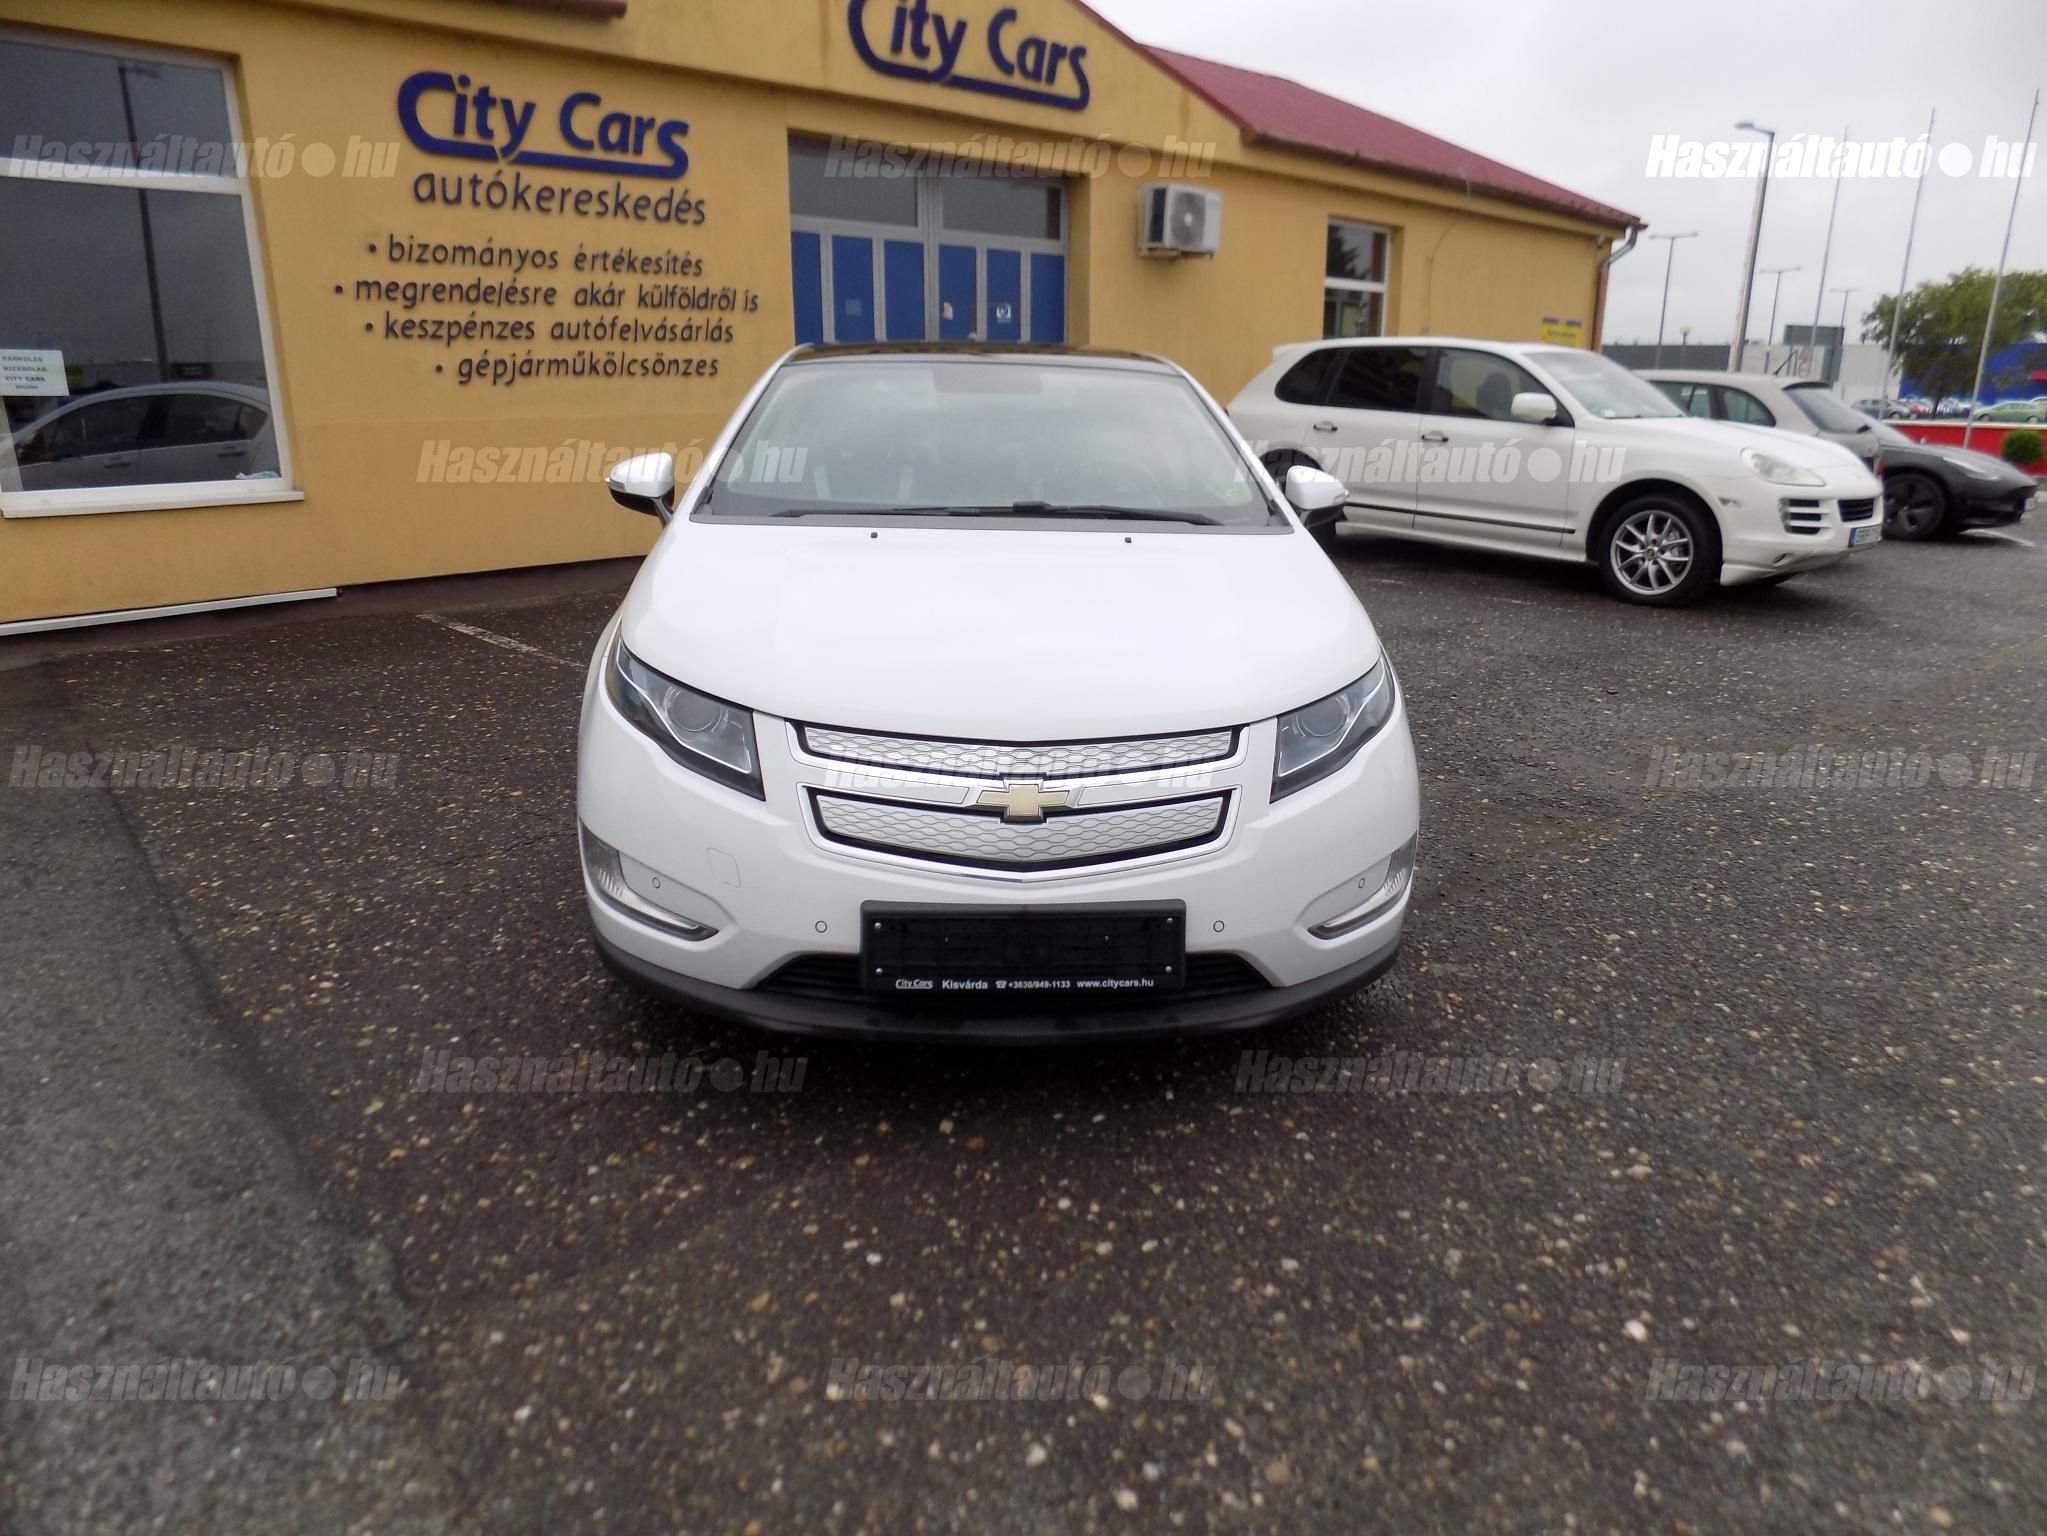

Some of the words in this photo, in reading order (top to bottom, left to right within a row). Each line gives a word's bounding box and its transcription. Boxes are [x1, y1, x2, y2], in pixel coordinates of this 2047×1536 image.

[847, 0, 967, 84] City
[987, 8, 1090, 112] Cars
[397, 70, 537, 163] City
[558, 91, 690, 181] Cars
[413, 169, 705, 225] autókereskedés
[388, 233, 559, 274] bizományos
[574, 243, 704, 278] értékesítés
[355, 277, 557, 309] megrendelésre
[574, 281, 625, 308] akár
[637, 283, 736, 314] külföldről
[744, 290, 760, 313] is
[384, 311, 535, 348] keszpénzes
[550, 315, 734, 344] autófelvásárlás
[458, 349, 718, 386] gépjárműkölcsönzes
[942, 979, 988, 990] Kisvárda
[1077, 978, 1154, 990] www.citycars.hu
